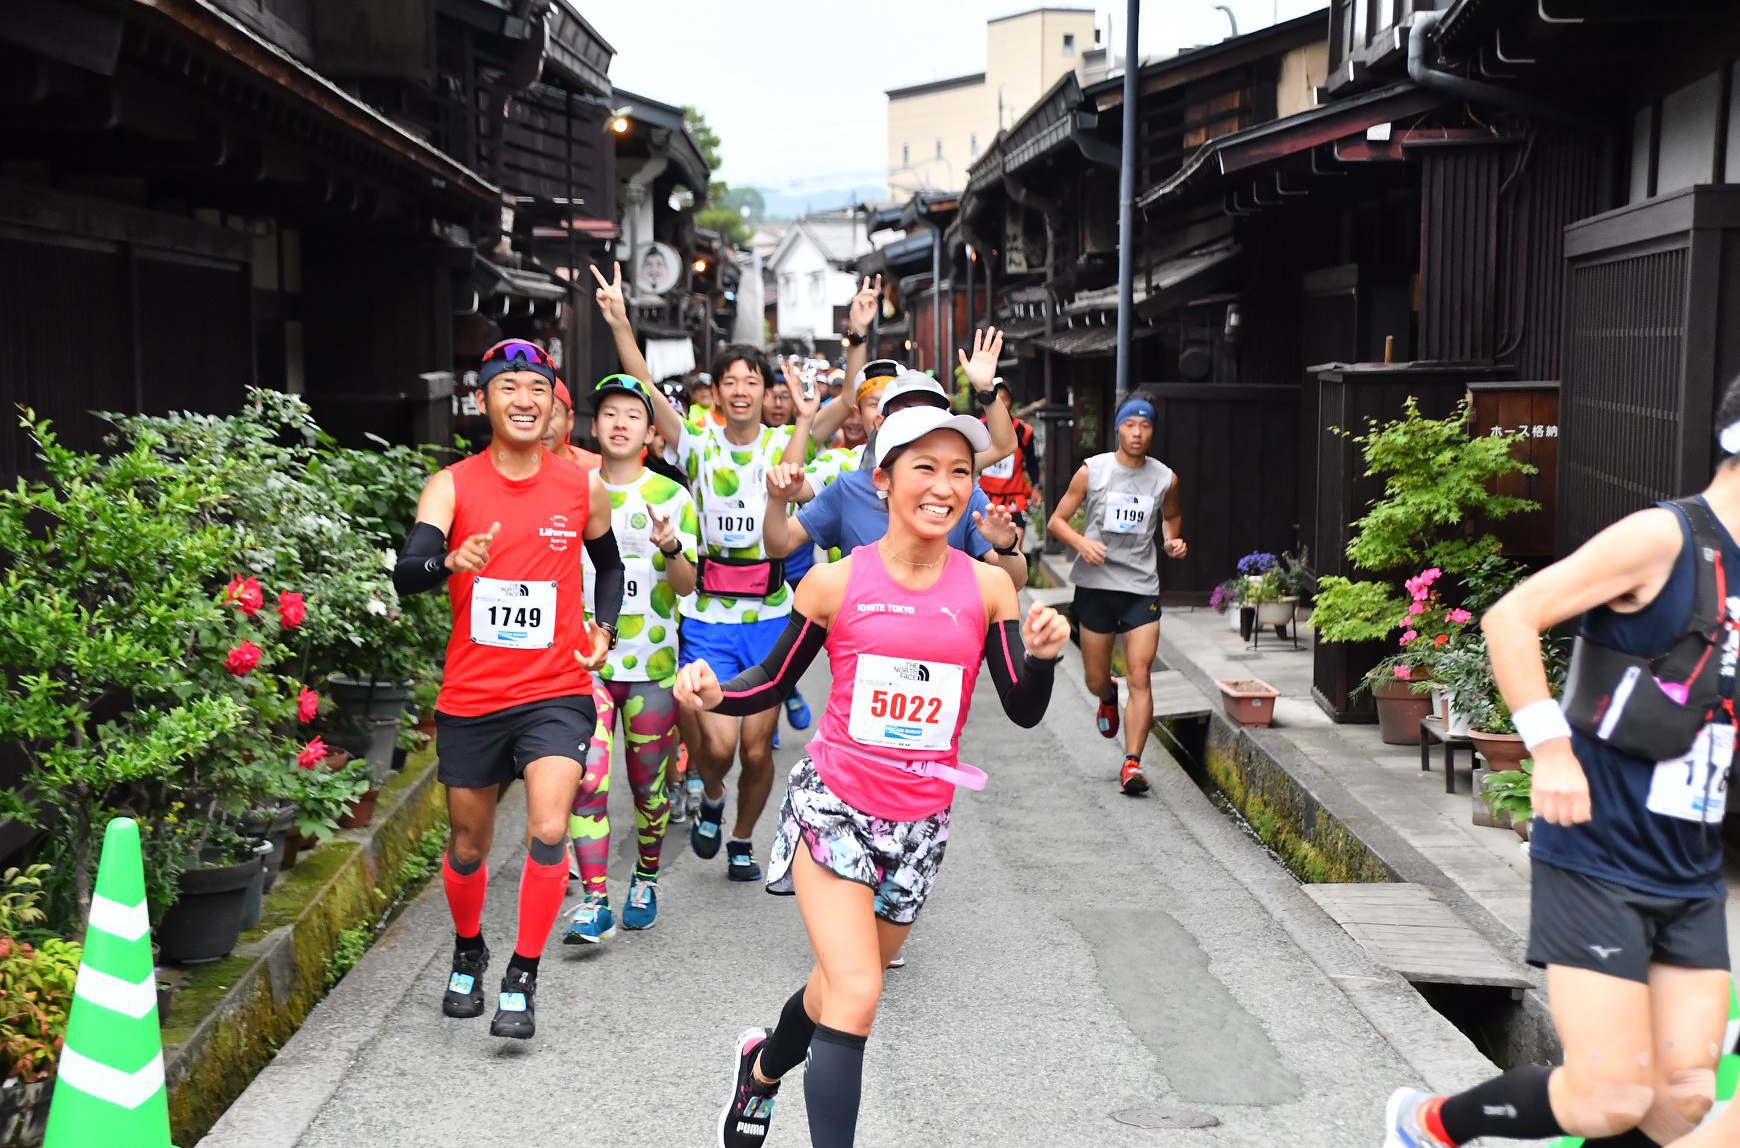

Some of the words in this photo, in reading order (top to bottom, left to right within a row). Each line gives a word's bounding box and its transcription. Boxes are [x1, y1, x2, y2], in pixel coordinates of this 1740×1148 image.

[1490, 425, 1558, 438] ホース格納
[1116, 508, 1144, 522] 1199
[717, 516, 754, 531] 1070
[857, 603, 886, 612] IGNITE
[888, 604, 915, 614] TOKYO
[488, 606, 541, 628] 1749
[893, 667, 918, 675] NORTH
[871, 690, 942, 724] 5022
[736, 1121, 764, 1136] PUMA
